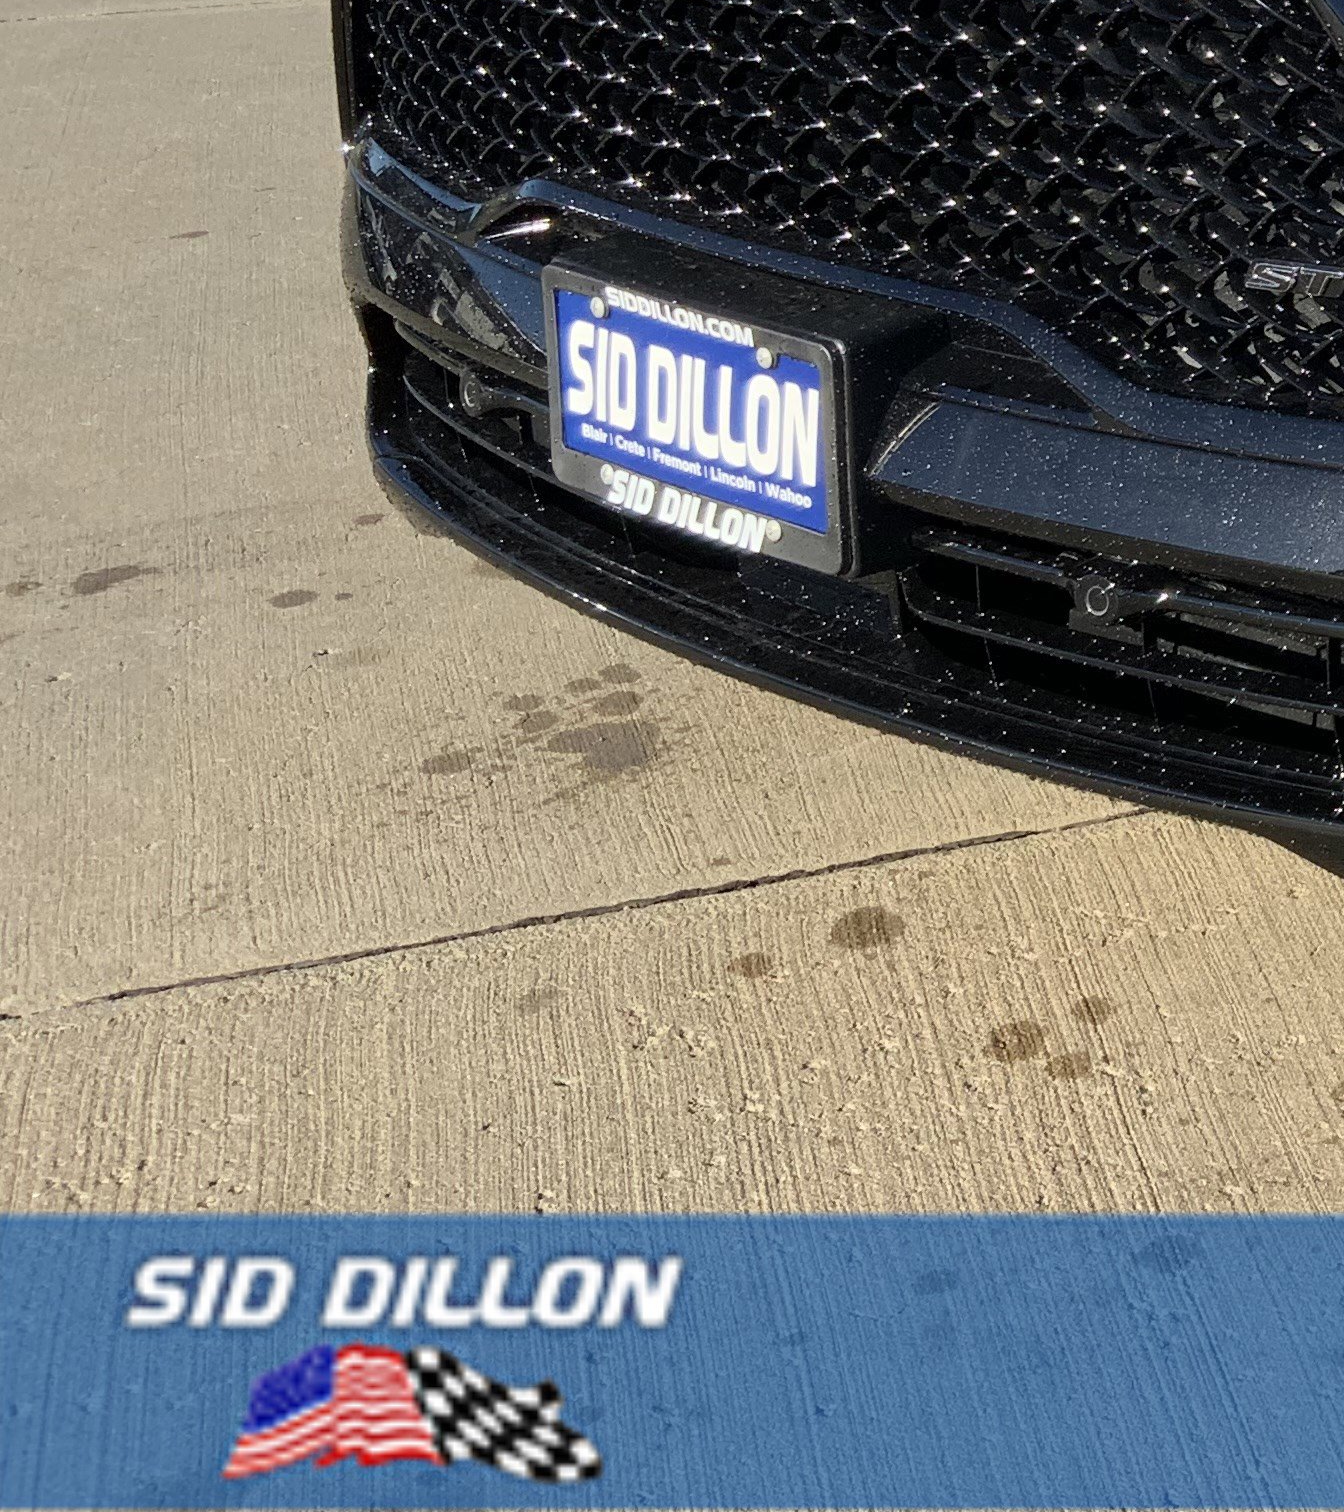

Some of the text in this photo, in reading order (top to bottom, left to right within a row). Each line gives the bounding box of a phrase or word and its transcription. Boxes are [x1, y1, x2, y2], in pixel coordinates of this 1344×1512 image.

[604, 286, 755, 348] SIDDILLON.COM
[567, 319, 821, 488] SID DILLON
[581, 422, 813, 510] Blair Crete Fremont Lincoln Wahoo
[607, 469, 768, 554] SID DILLON
